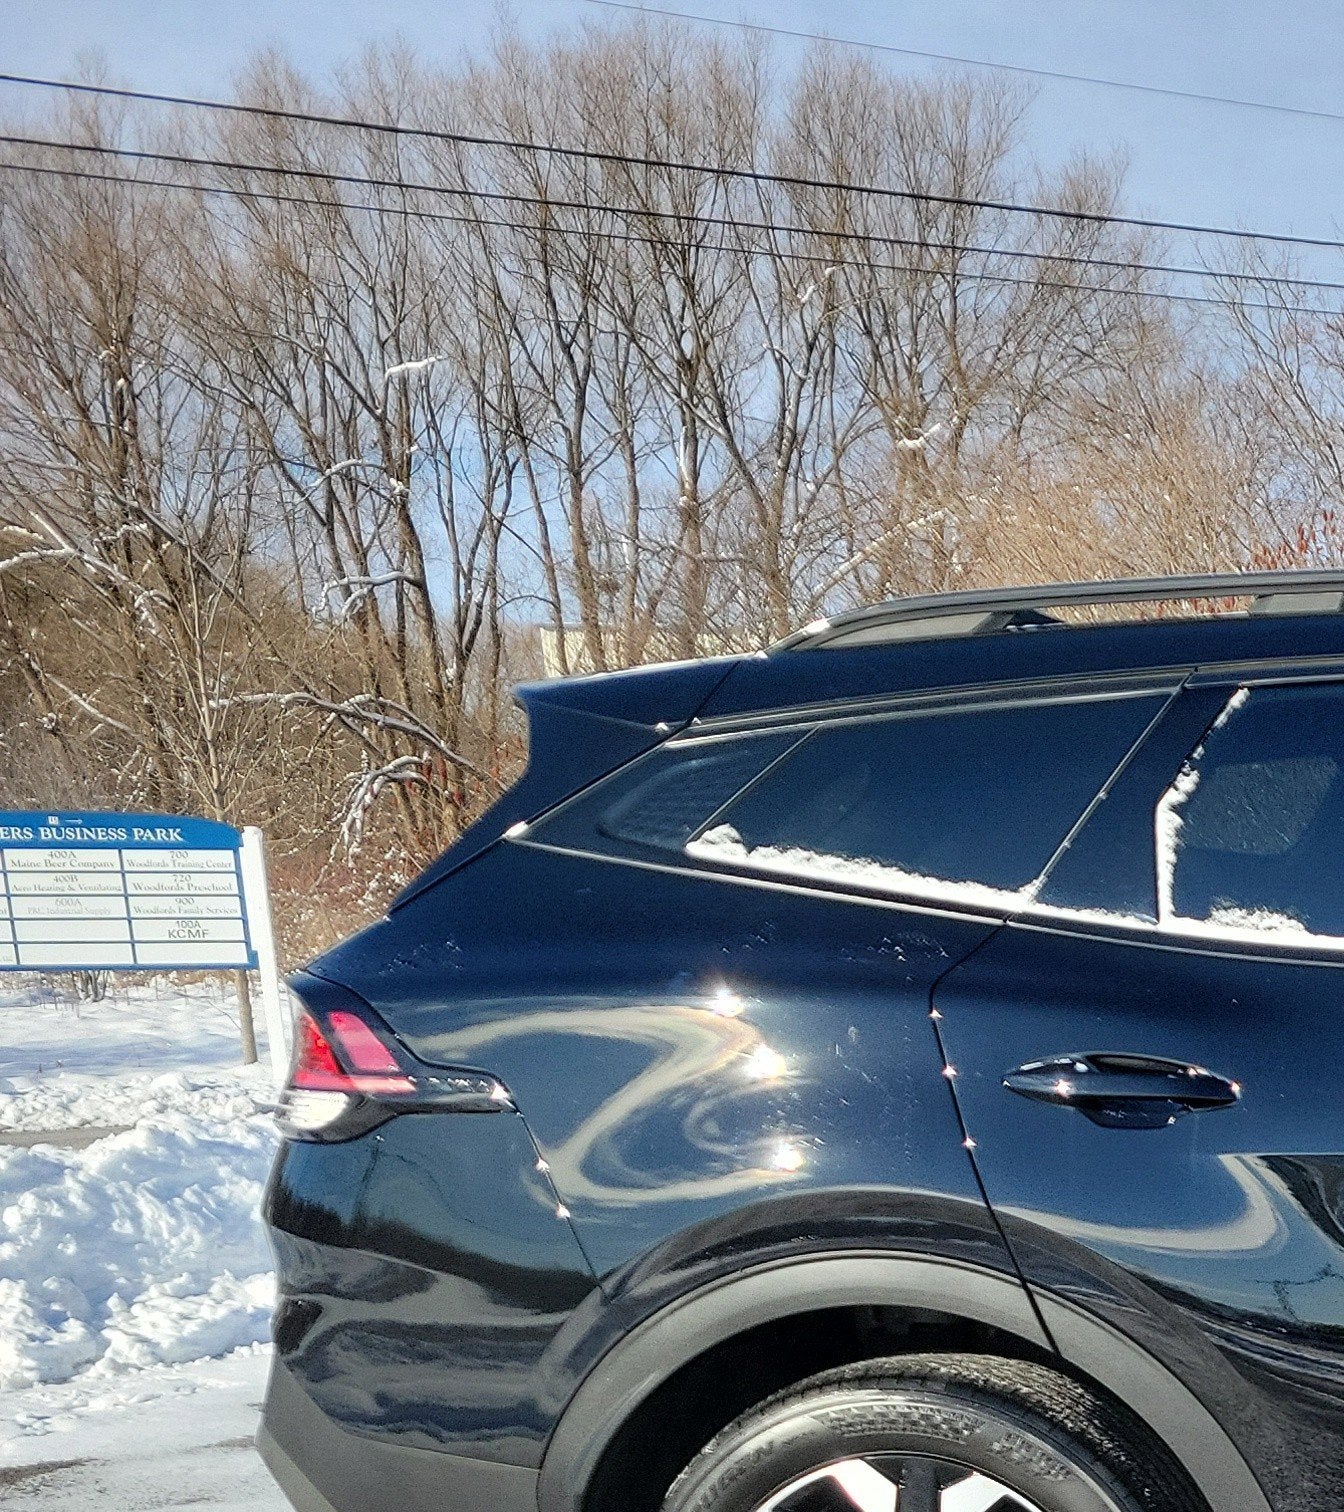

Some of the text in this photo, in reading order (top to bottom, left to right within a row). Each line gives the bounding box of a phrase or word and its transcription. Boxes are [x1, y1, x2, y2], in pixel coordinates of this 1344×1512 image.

[38, 827, 127, 841] BUSINESS
[131, 828, 184, 841] PARK
[48, 851, 77, 859] 400A
[168, 851, 189, 859] 700
[10, 859, 42, 868] Maine
[69, 859, 115, 869] Company
[205, 860, 232, 868] Center
[187, 883, 233, 891] Preschool
[175, 898, 195, 906] 900
[168, 930, 209, 939] KCMF
